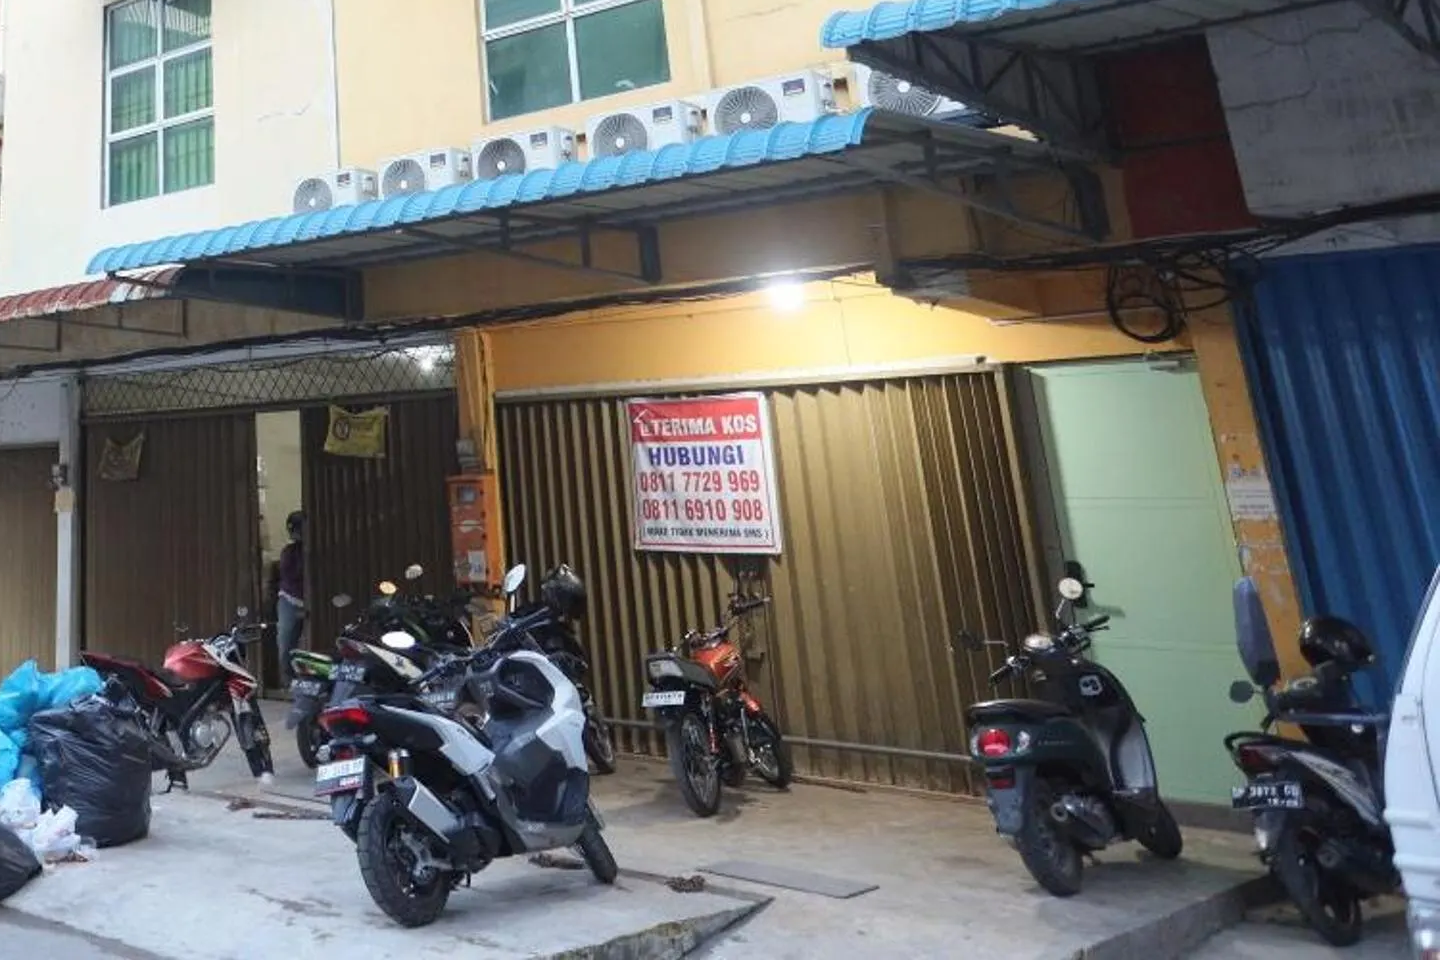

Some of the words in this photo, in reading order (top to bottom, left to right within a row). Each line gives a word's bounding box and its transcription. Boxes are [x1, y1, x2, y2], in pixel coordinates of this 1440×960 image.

[651, 417, 717, 437] TERIMA
[722, 414, 758, 436] KOS
[648, 444, 744, 466] HUBUNGI
[640, 471, 675, 493] 0811
[682, 471, 723, 493] 7729
[728, 470, 760, 492] 969
[643, 499, 679, 520] 0811
[685, 499, 727, 520] 6910
[732, 499, 764, 520] 908
